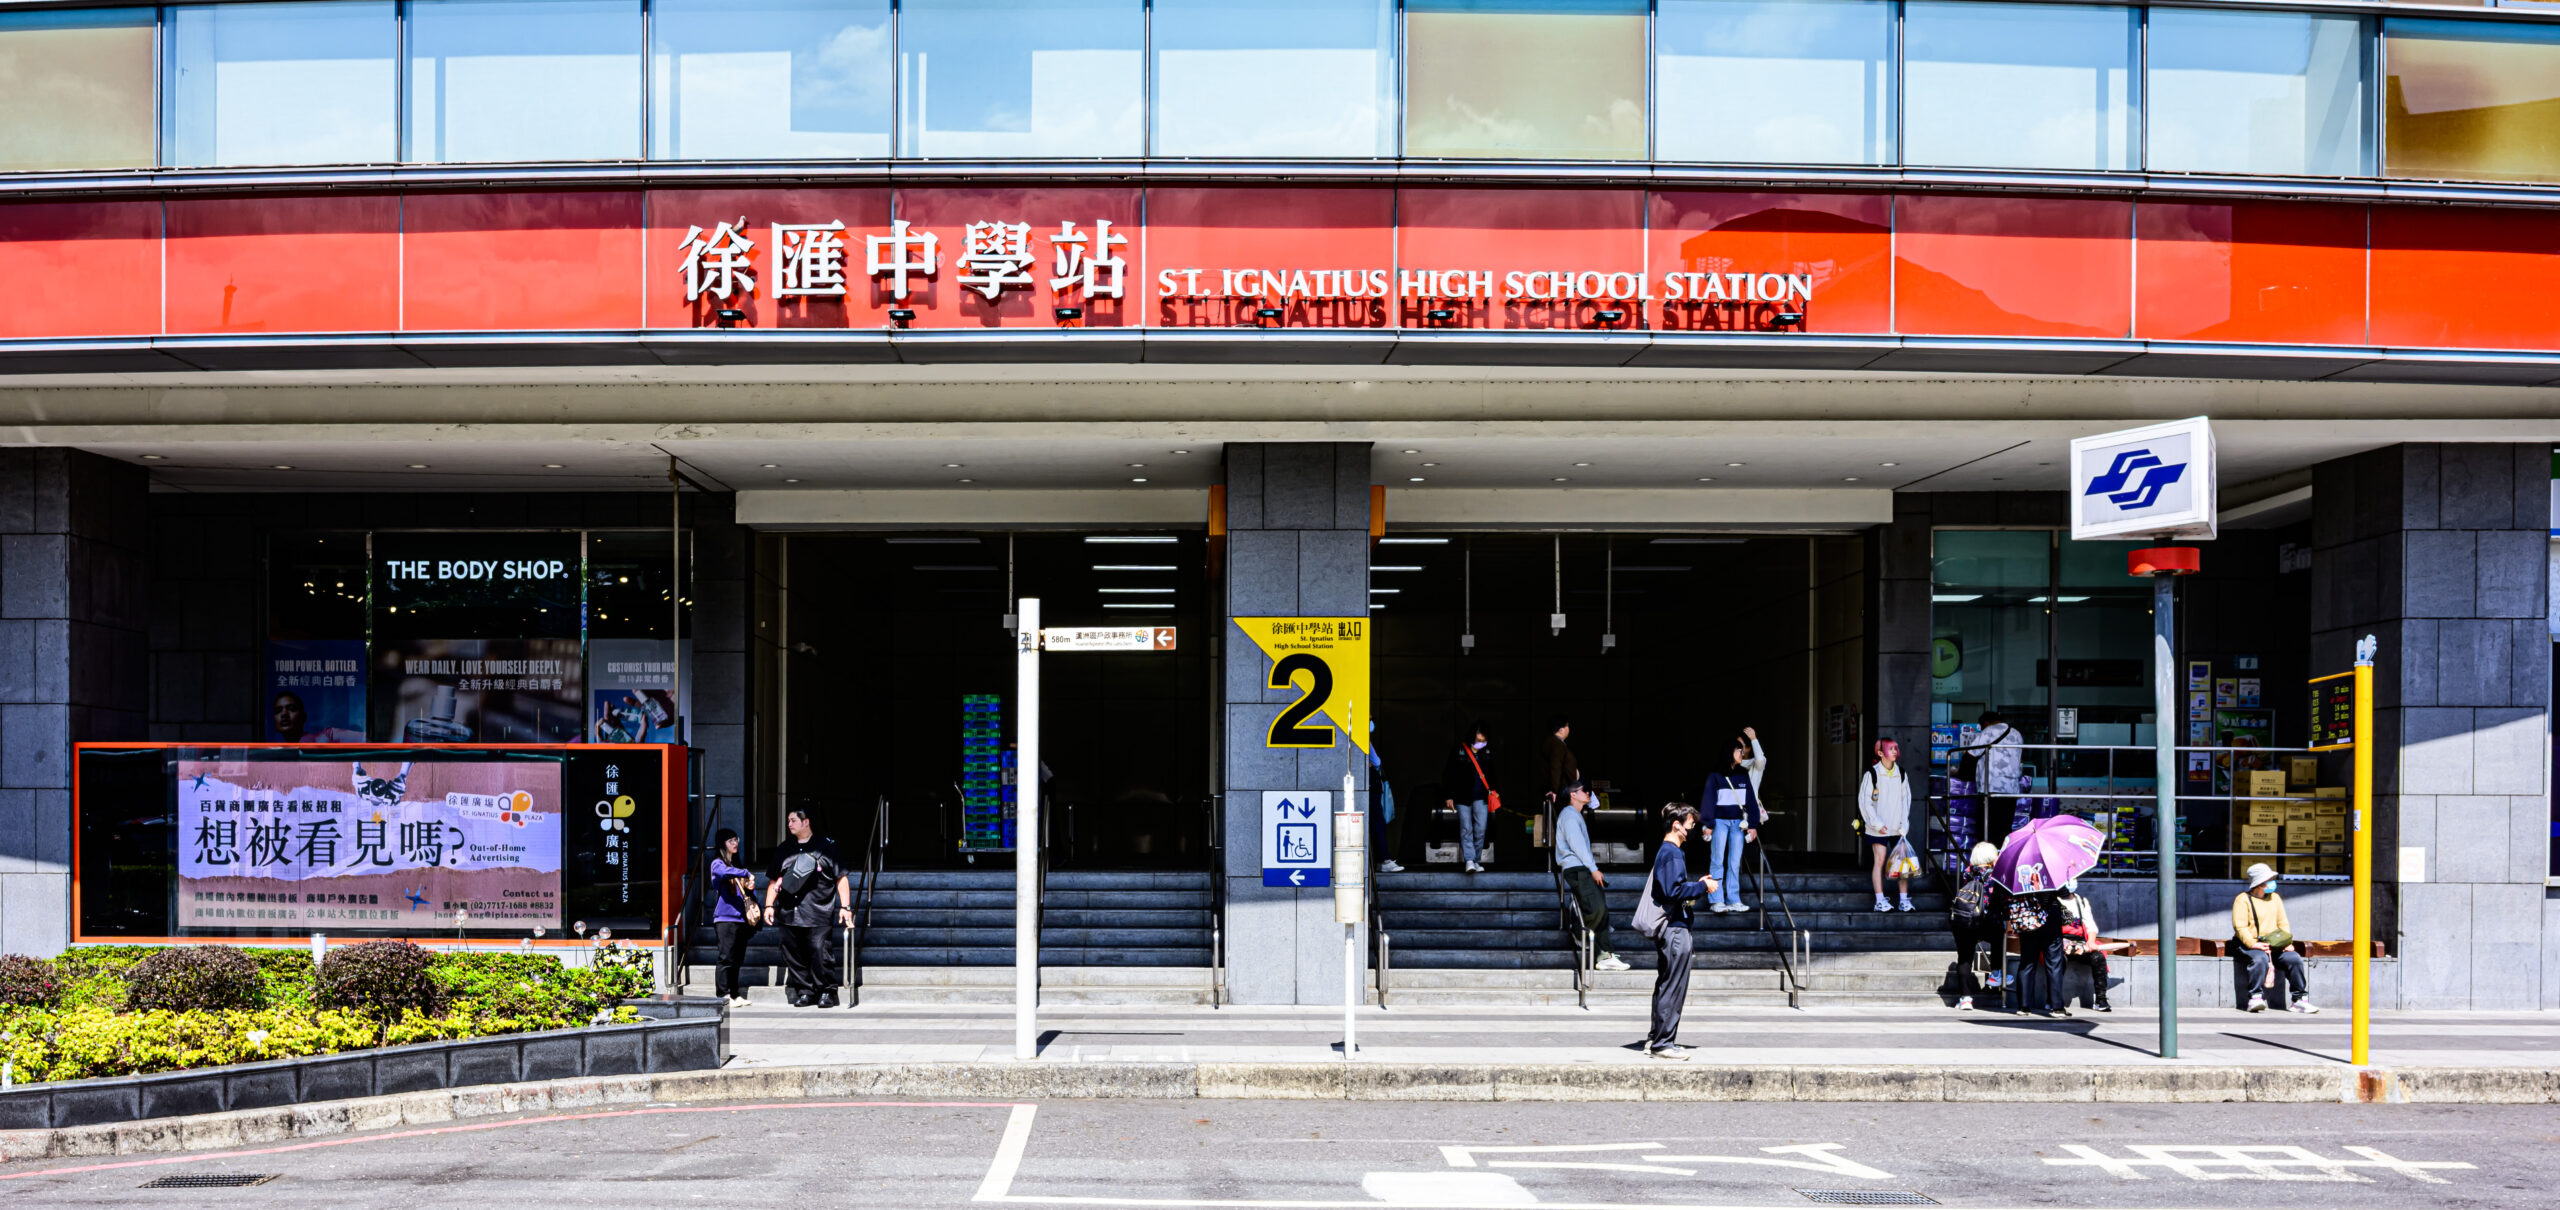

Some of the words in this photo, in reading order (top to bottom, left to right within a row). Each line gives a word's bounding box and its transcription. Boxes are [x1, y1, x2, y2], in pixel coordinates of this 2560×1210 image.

[677, 219, 1129, 302] 徐匯中學站
[1158, 268, 1211, 298] ST.
[1223, 268, 1388, 298] IGNATIUS
[1400, 269, 1494, 298] HIGH
[1505, 269, 1654, 300] SCHOOL
[1664, 271, 1812, 302] STATION
[387, 560, 431, 580] THE
[438, 560, 498, 580] BODY
[1272, 621, 1334, 635] 徐匯中學站
[1338, 621, 1361, 637] 出入口
[1051, 635, 1071, 644] 580m
[1309, 635, 1334, 643] Ignatius
[275, 659, 295, 672] YOUR
[296, 659, 324, 673] POWER,
[325, 659, 359, 673] BOTTLED.
[405, 659, 430, 675] WEAR
[432, 659, 459, 675] DAILY.
[461, 659, 483, 675] LOVE
[485, 659, 528, 675] YOURSELF
[529, 659, 563, 675] DEEPLY.
[661, 662, 675, 673] MUS
[1268, 652, 1335, 746] 2
[448, 795, 494, 808] 徐匯廣場
[194, 815, 465, 867] 想被看見嗎?
[470, 843, 526, 852] Out-of-Home
[470, 853, 520, 863] Advertising
[621, 852, 629, 881] IGNATIUS
[502, 889, 540, 898] Contact
[542, 890, 554, 898] us
[621, 882, 629, 904] PLAZA
